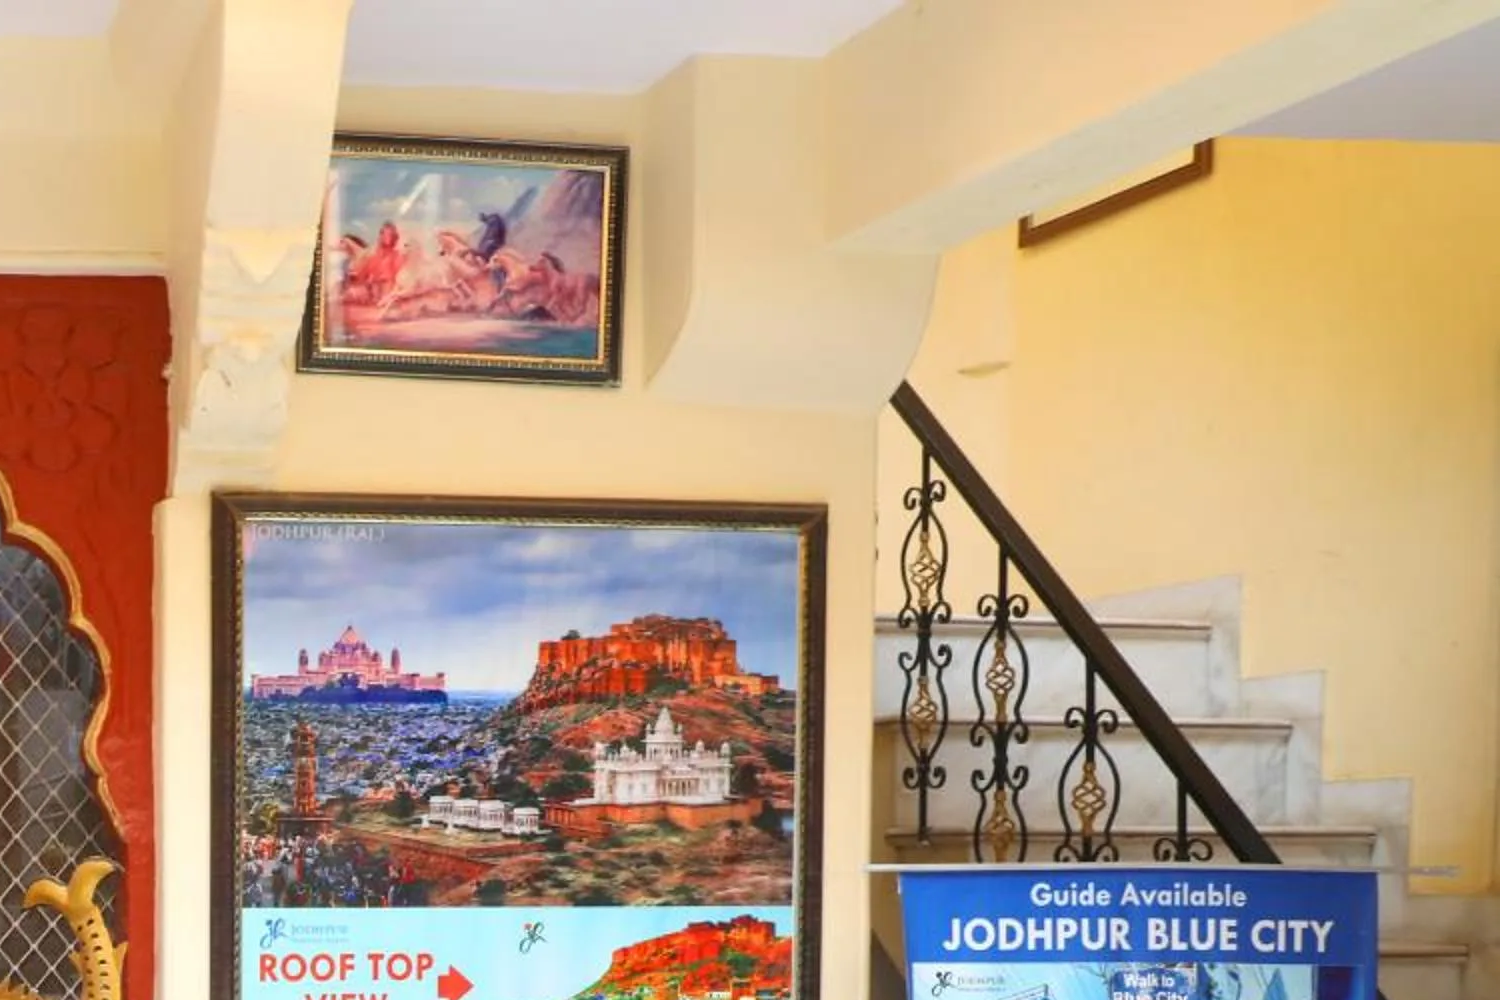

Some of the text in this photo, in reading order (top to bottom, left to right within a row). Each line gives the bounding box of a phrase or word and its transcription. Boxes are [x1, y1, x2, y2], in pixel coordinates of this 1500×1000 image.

[1029, 882, 1247, 907] Guide Available
[942, 918, 1334, 953] JODHPUR BLUE CITY
[259, 952, 434, 982] ROOF TOP
